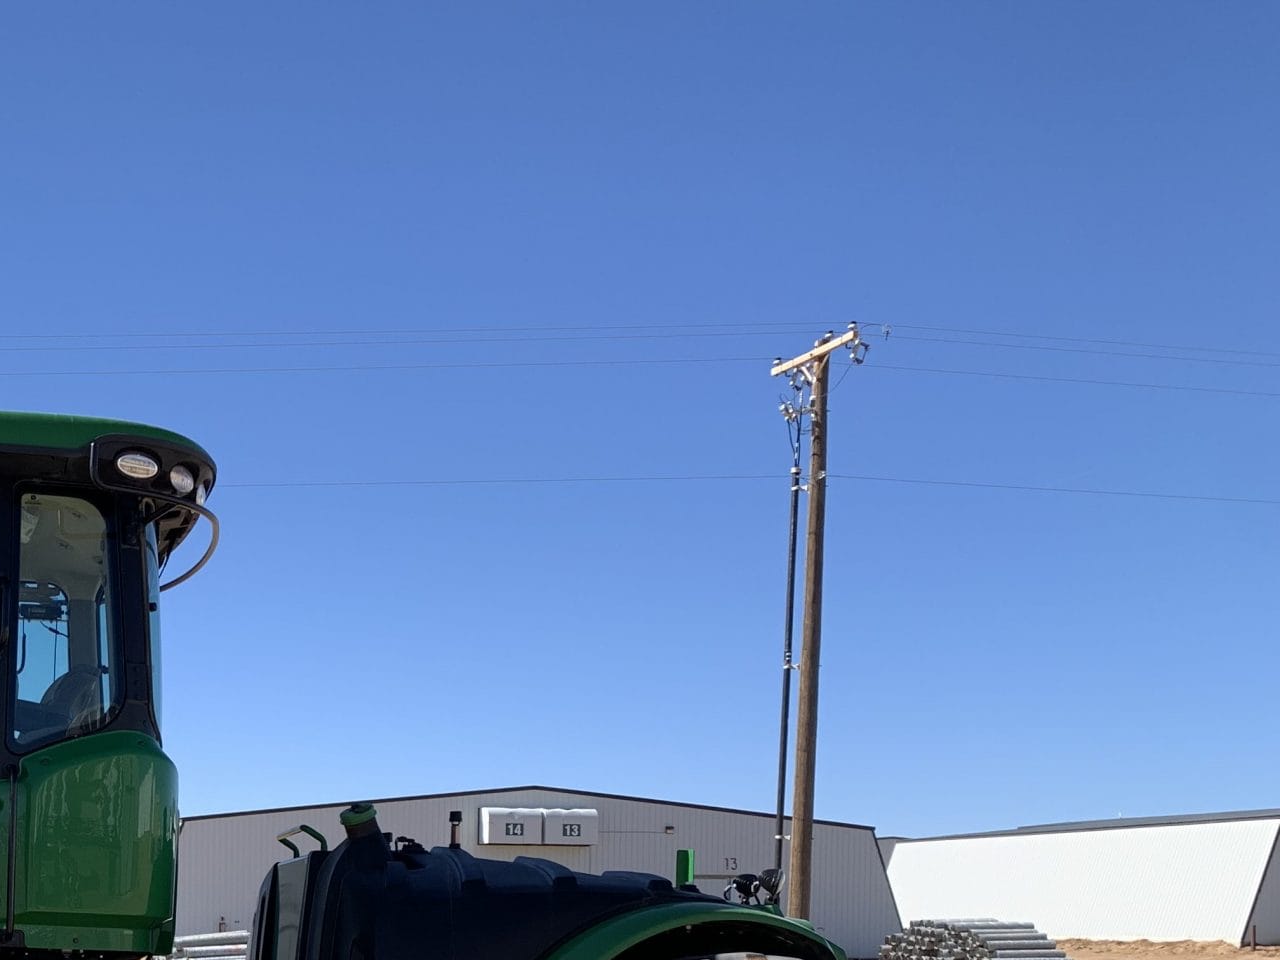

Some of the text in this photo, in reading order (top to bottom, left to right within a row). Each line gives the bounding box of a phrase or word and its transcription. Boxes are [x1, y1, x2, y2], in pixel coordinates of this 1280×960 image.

[507, 824, 522, 835] 14
[564, 825, 579, 836] 13
[724, 857, 738, 871] 13
